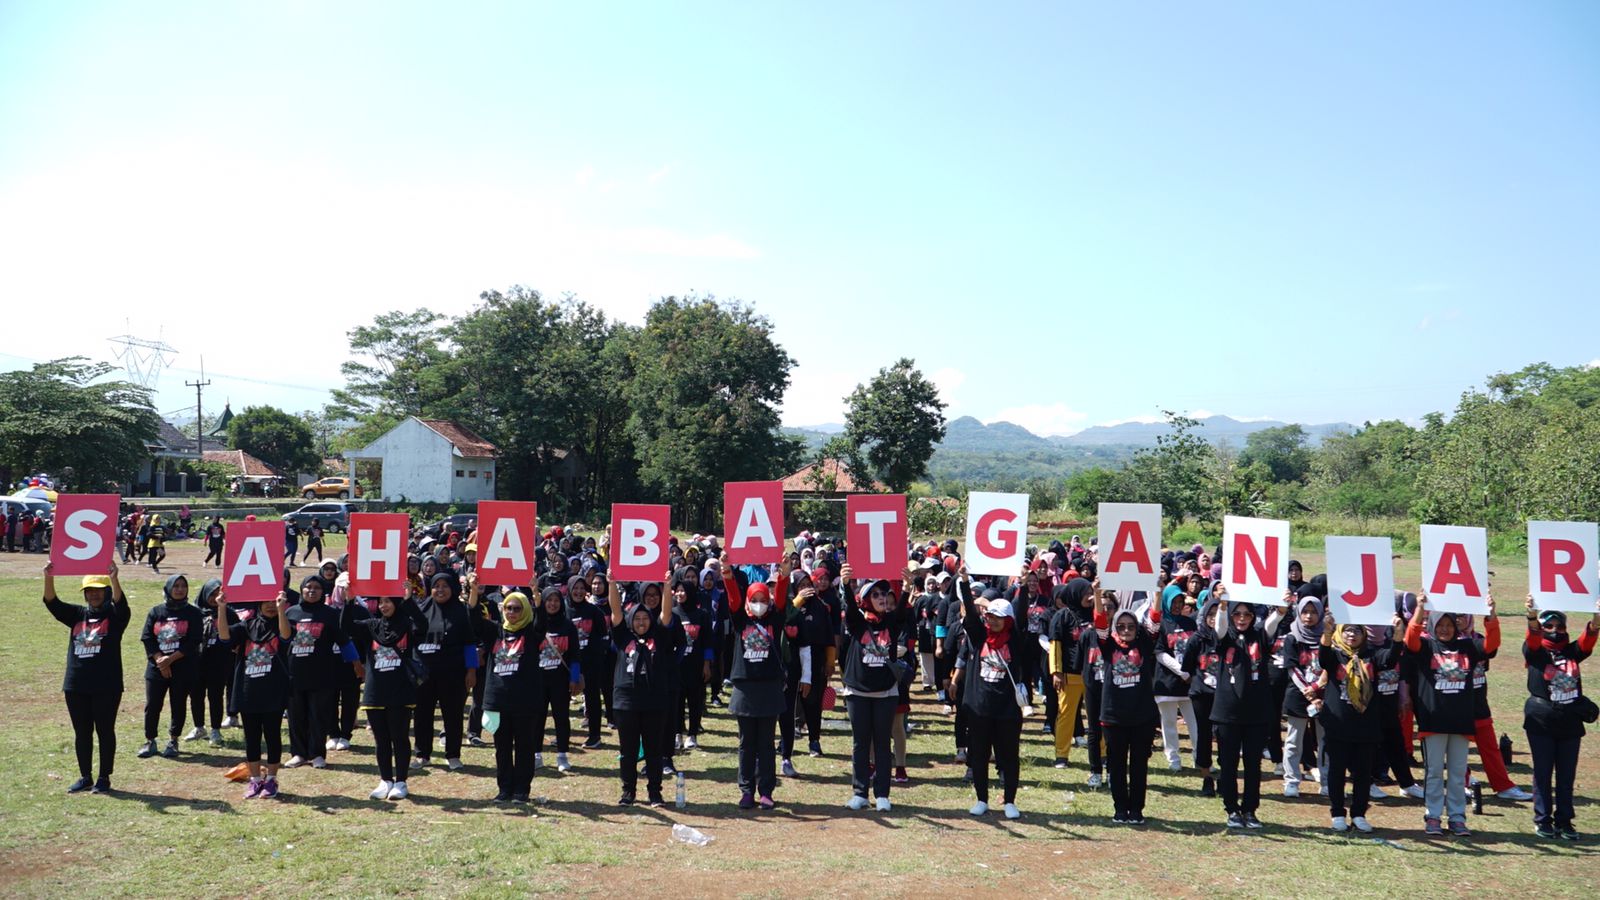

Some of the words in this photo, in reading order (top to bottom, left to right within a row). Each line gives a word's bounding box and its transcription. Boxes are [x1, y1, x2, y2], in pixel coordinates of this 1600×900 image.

[64, 510, 107, 560] S
[482, 518, 527, 569] A
[620, 519, 660, 566] B
[731, 498, 778, 548] A
[855, 511, 897, 563] T
[976, 509, 1017, 559] G
[1106, 522, 1152, 573] A
[228, 537, 276, 586] A
[357, 530, 400, 580] H
[1233, 534, 1278, 587] N
[1343, 554, 1377, 606] J
[1431, 544, 1480, 596] A
[1540, 539, 1587, 593] R
